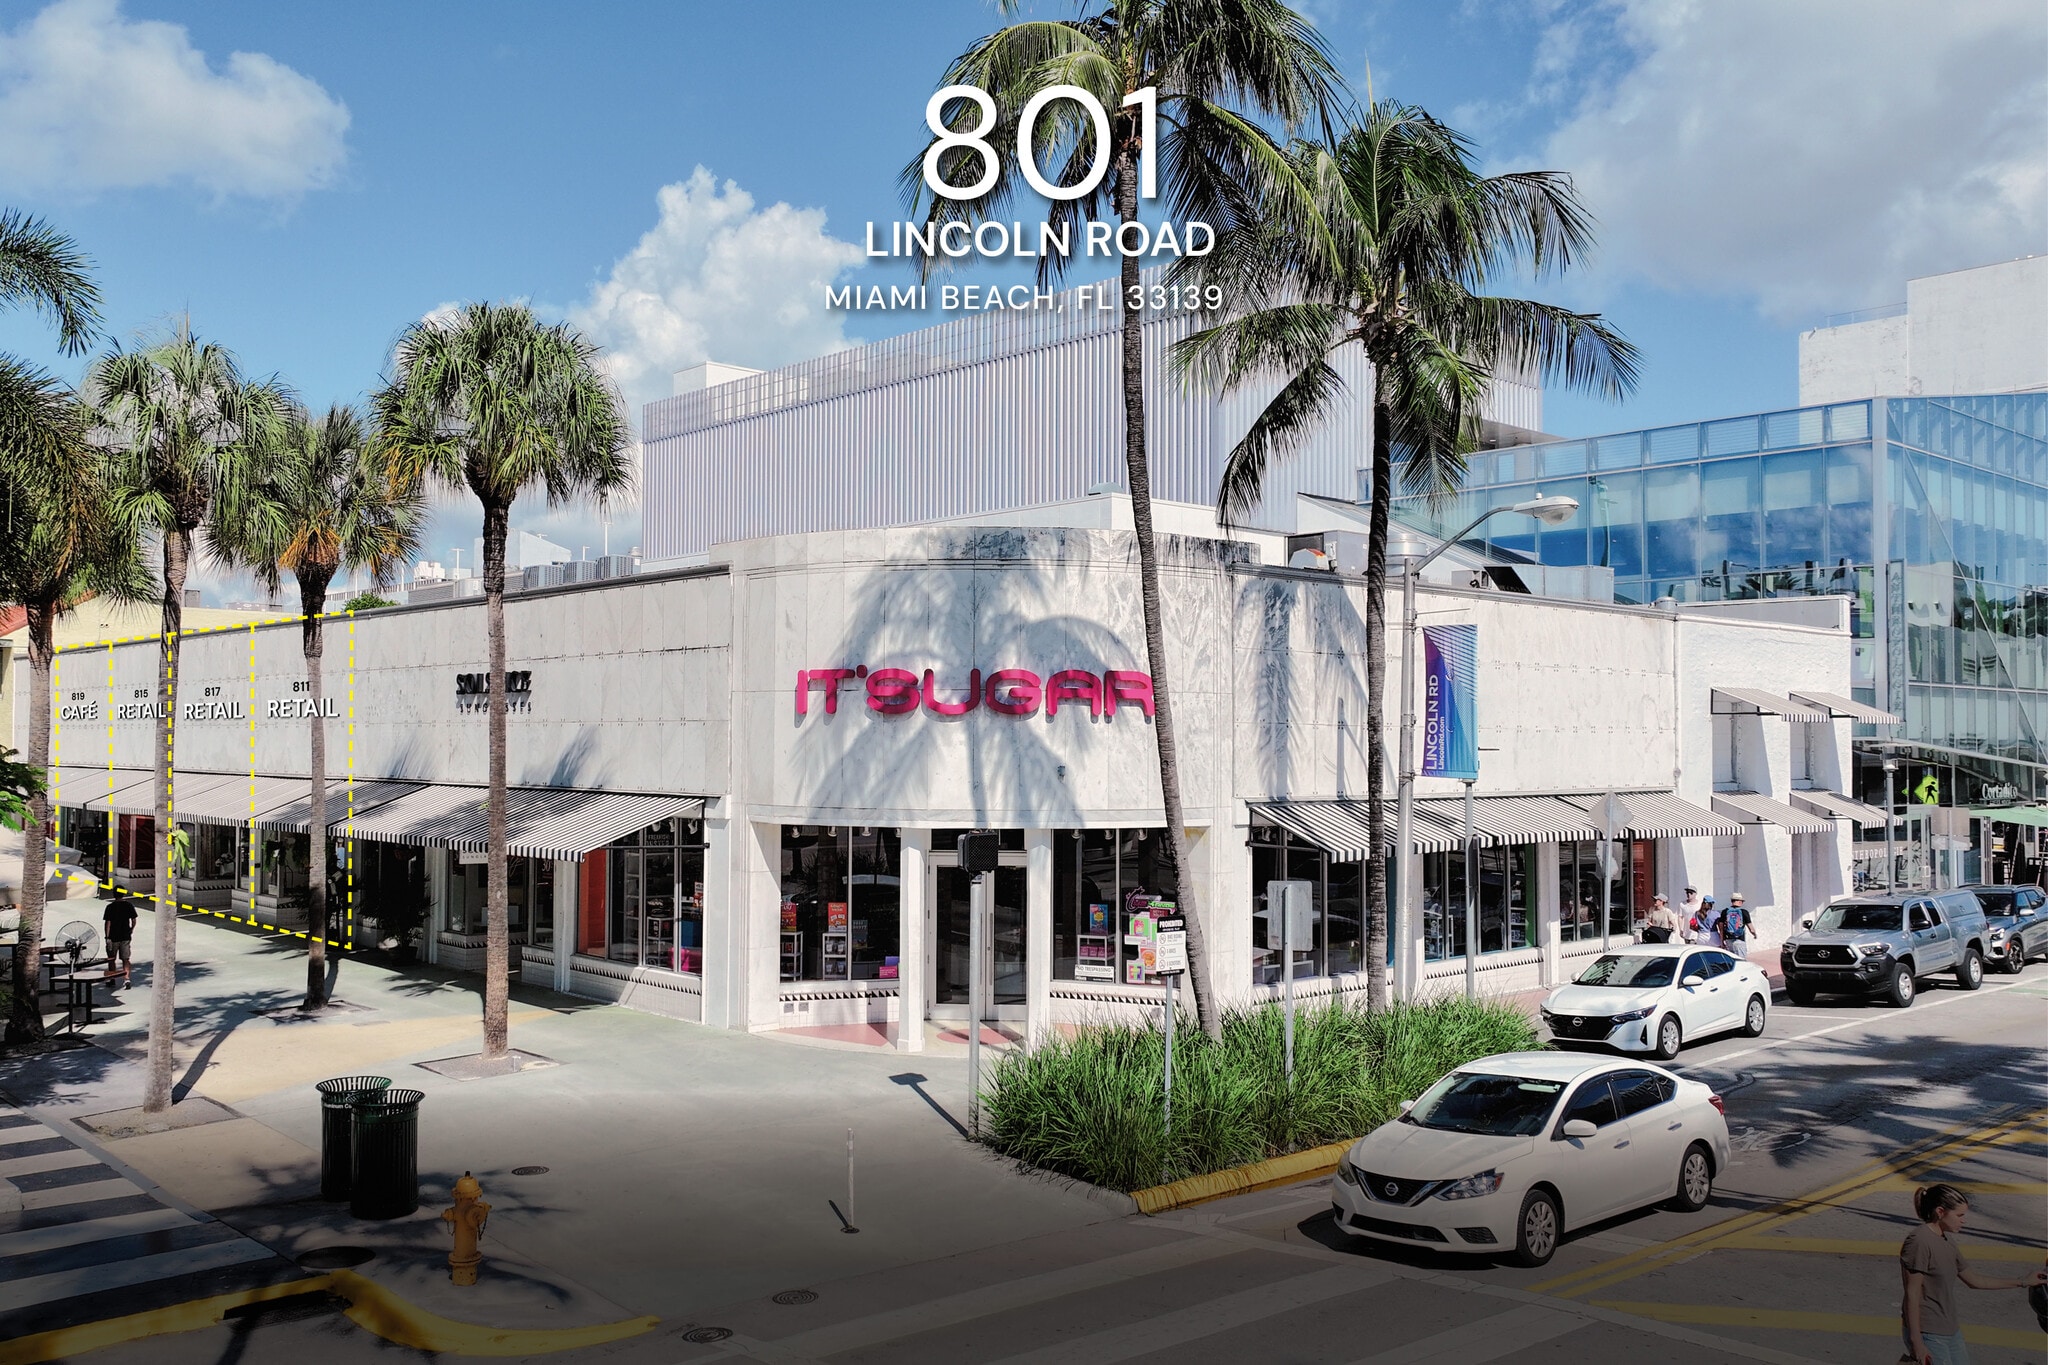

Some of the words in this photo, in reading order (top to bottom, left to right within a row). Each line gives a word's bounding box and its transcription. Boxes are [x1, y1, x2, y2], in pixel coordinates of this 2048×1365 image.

[797, 664, 1155, 716] IT'SUGAR
[1429, 674, 1438, 697] RD
[460, 702, 532, 714] SUNGSSES
[1426, 700, 1438, 770] LINCOLN
[1438, 716, 1446, 770] LincolnRd.com
[1982, 782, 2018, 799] Cortadito
